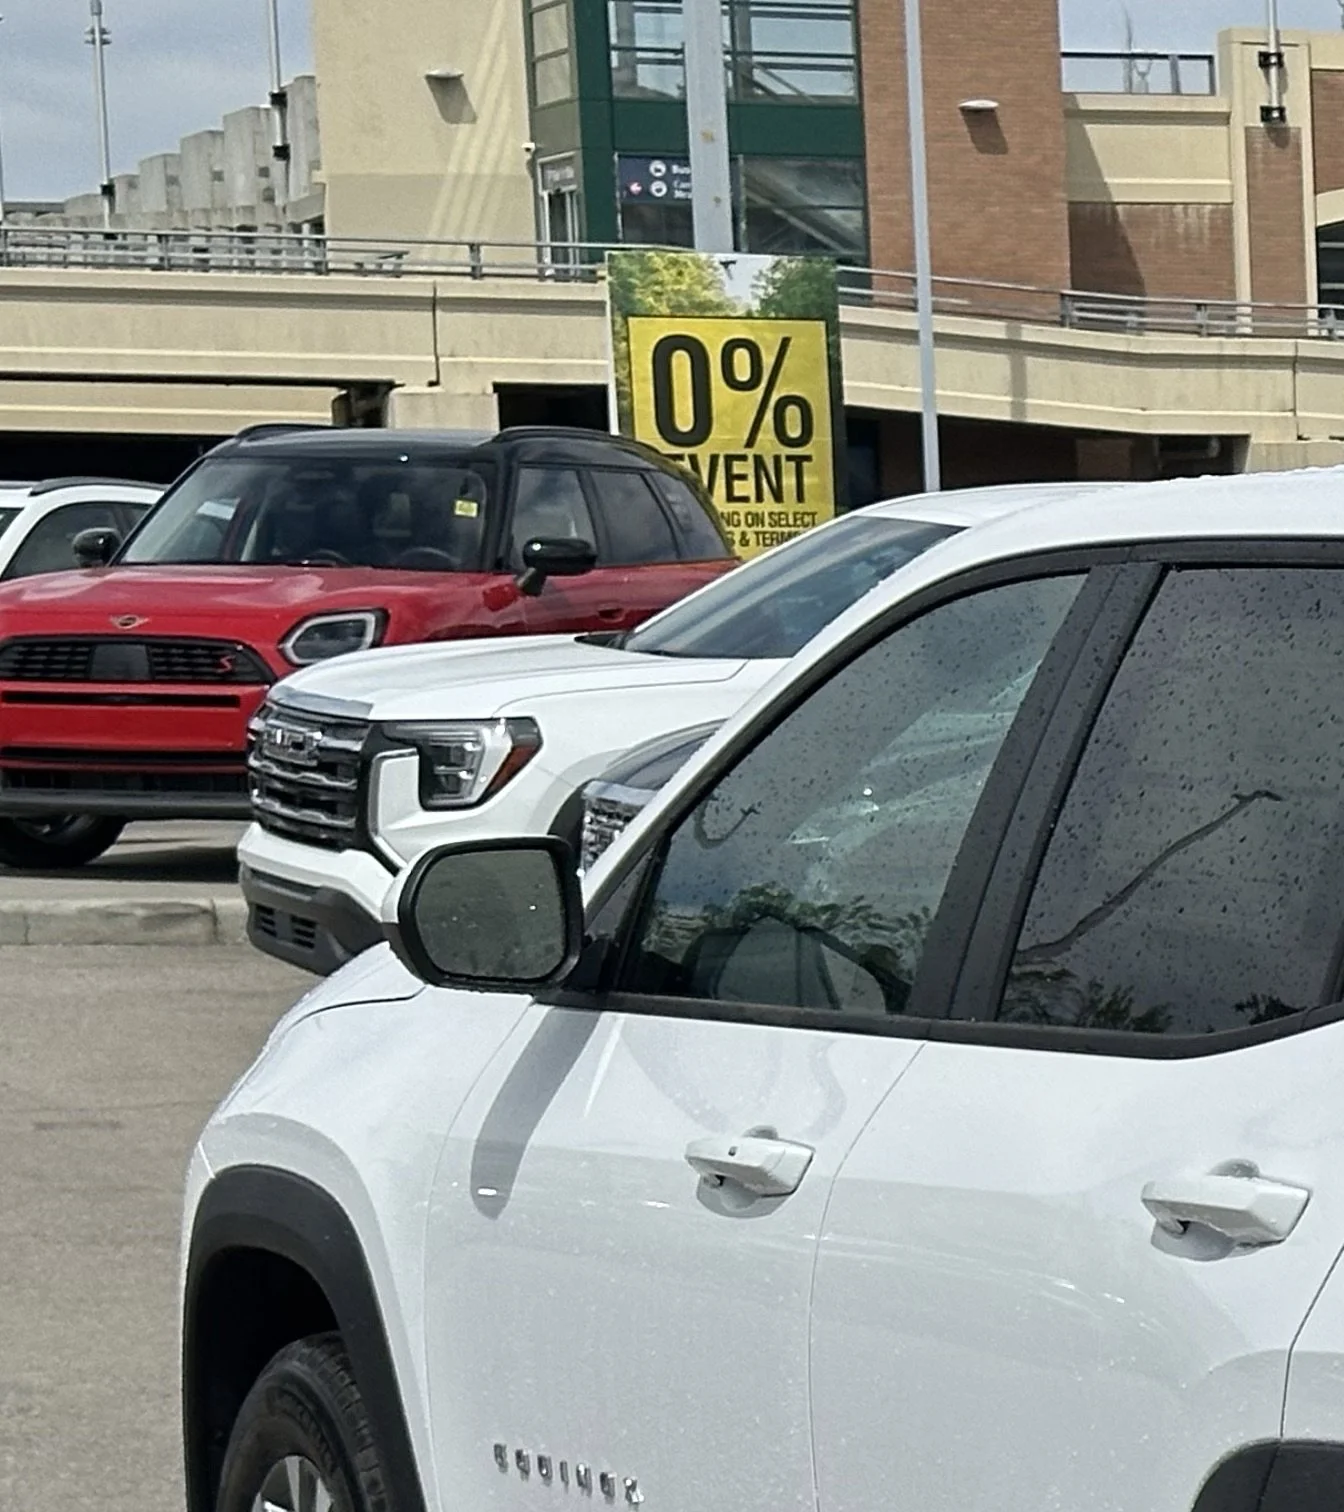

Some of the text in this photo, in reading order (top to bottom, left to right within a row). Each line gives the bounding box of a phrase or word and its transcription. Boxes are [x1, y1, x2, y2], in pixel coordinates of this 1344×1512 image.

[652, 334, 814, 449] 0%
[744, 511, 765, 528] ON
[768, 511, 818, 528] SELECT
[739, 532, 750, 547] &
